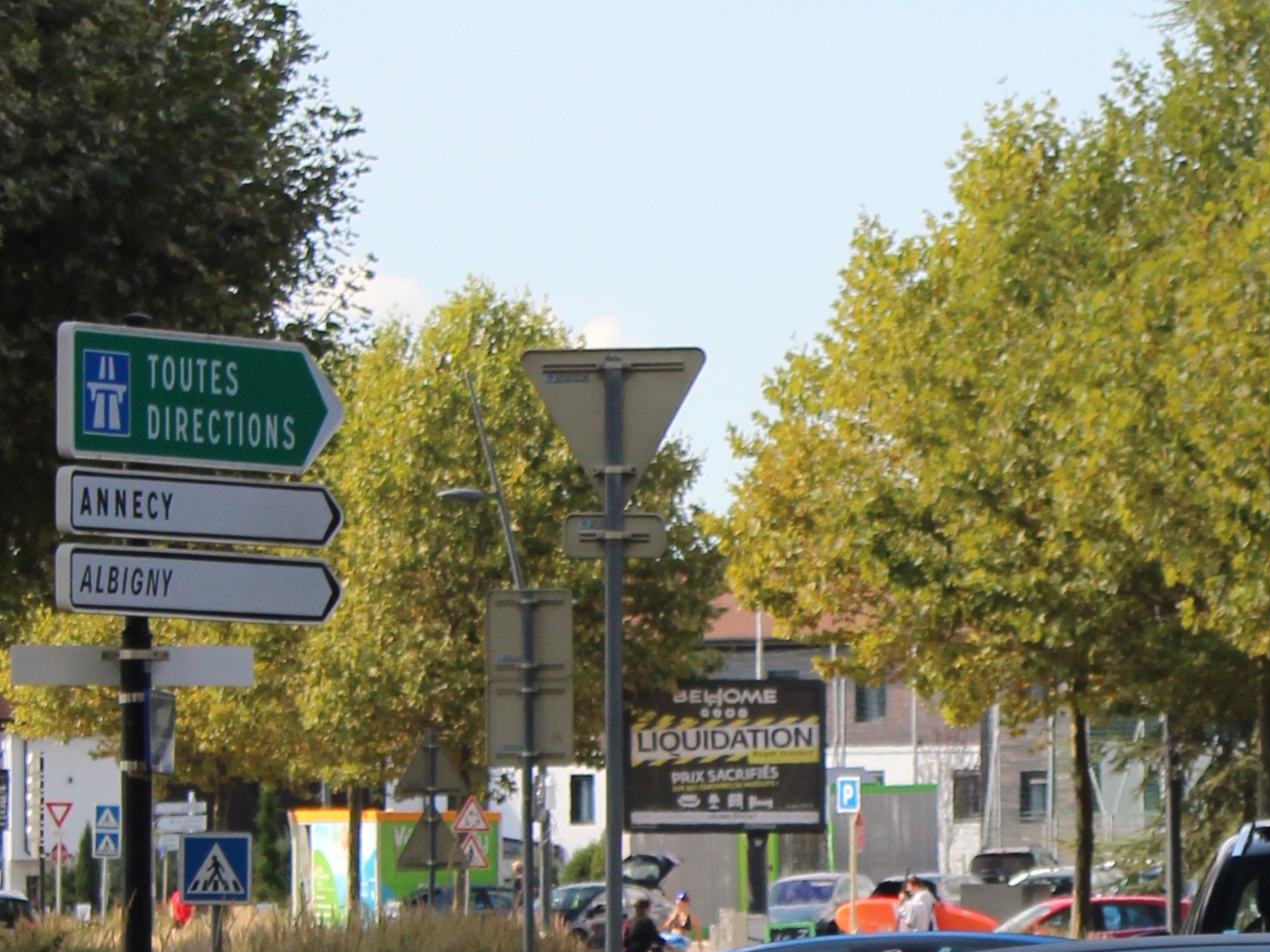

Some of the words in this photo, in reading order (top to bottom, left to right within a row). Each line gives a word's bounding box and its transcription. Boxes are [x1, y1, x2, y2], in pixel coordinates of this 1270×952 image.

[148, 354, 239, 396] TOUTES
[147, 404, 296, 450] DIRECTIONS
[80, 487, 173, 520] ANNECY
[79, 565, 173, 598] ALBIGNY
[638, 727, 814, 756] LIQUIDATION
[671, 769, 705, 784] PRIX
[707, 764, 779, 782] SACRIFIÉS
